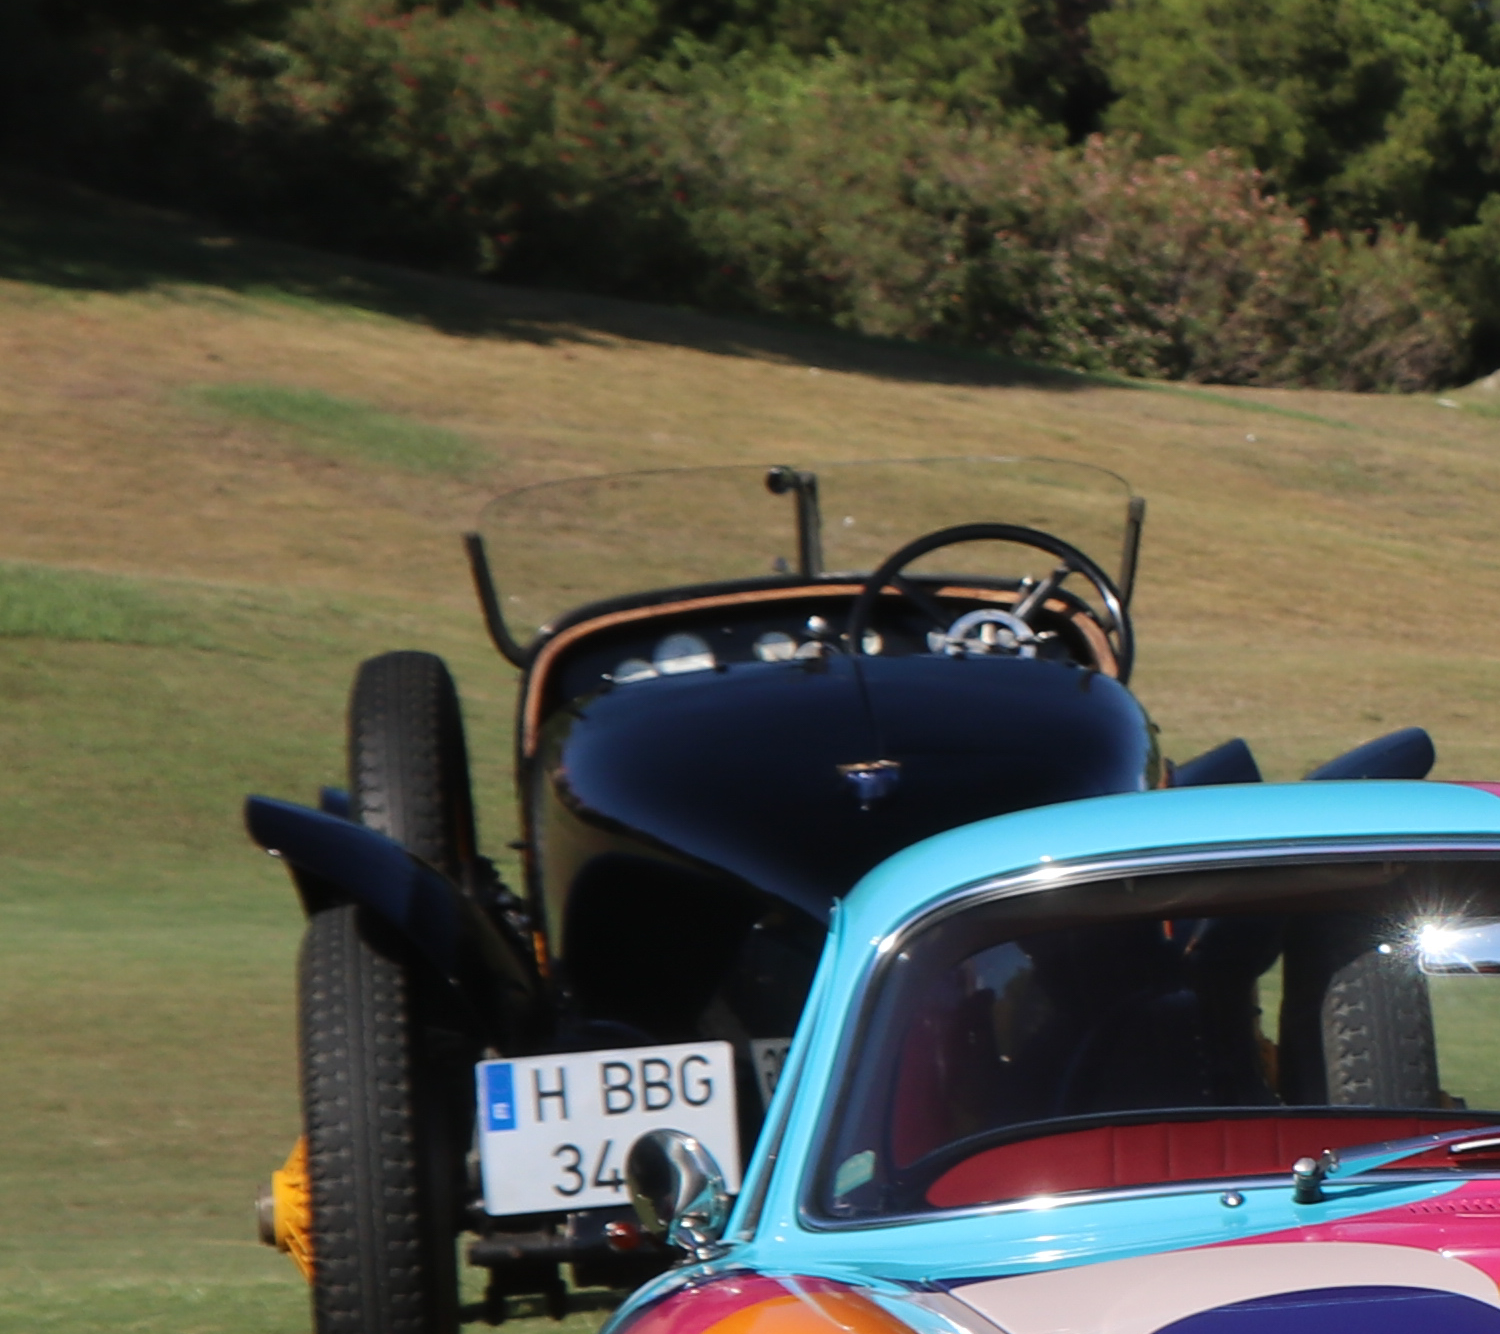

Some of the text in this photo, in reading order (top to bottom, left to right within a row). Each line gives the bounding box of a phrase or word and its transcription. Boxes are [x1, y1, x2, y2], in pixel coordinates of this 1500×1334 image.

[531, 1067, 569, 1122] H
[600, 1054, 713, 1116] BBG
[553, 1140, 626, 1197] 34
